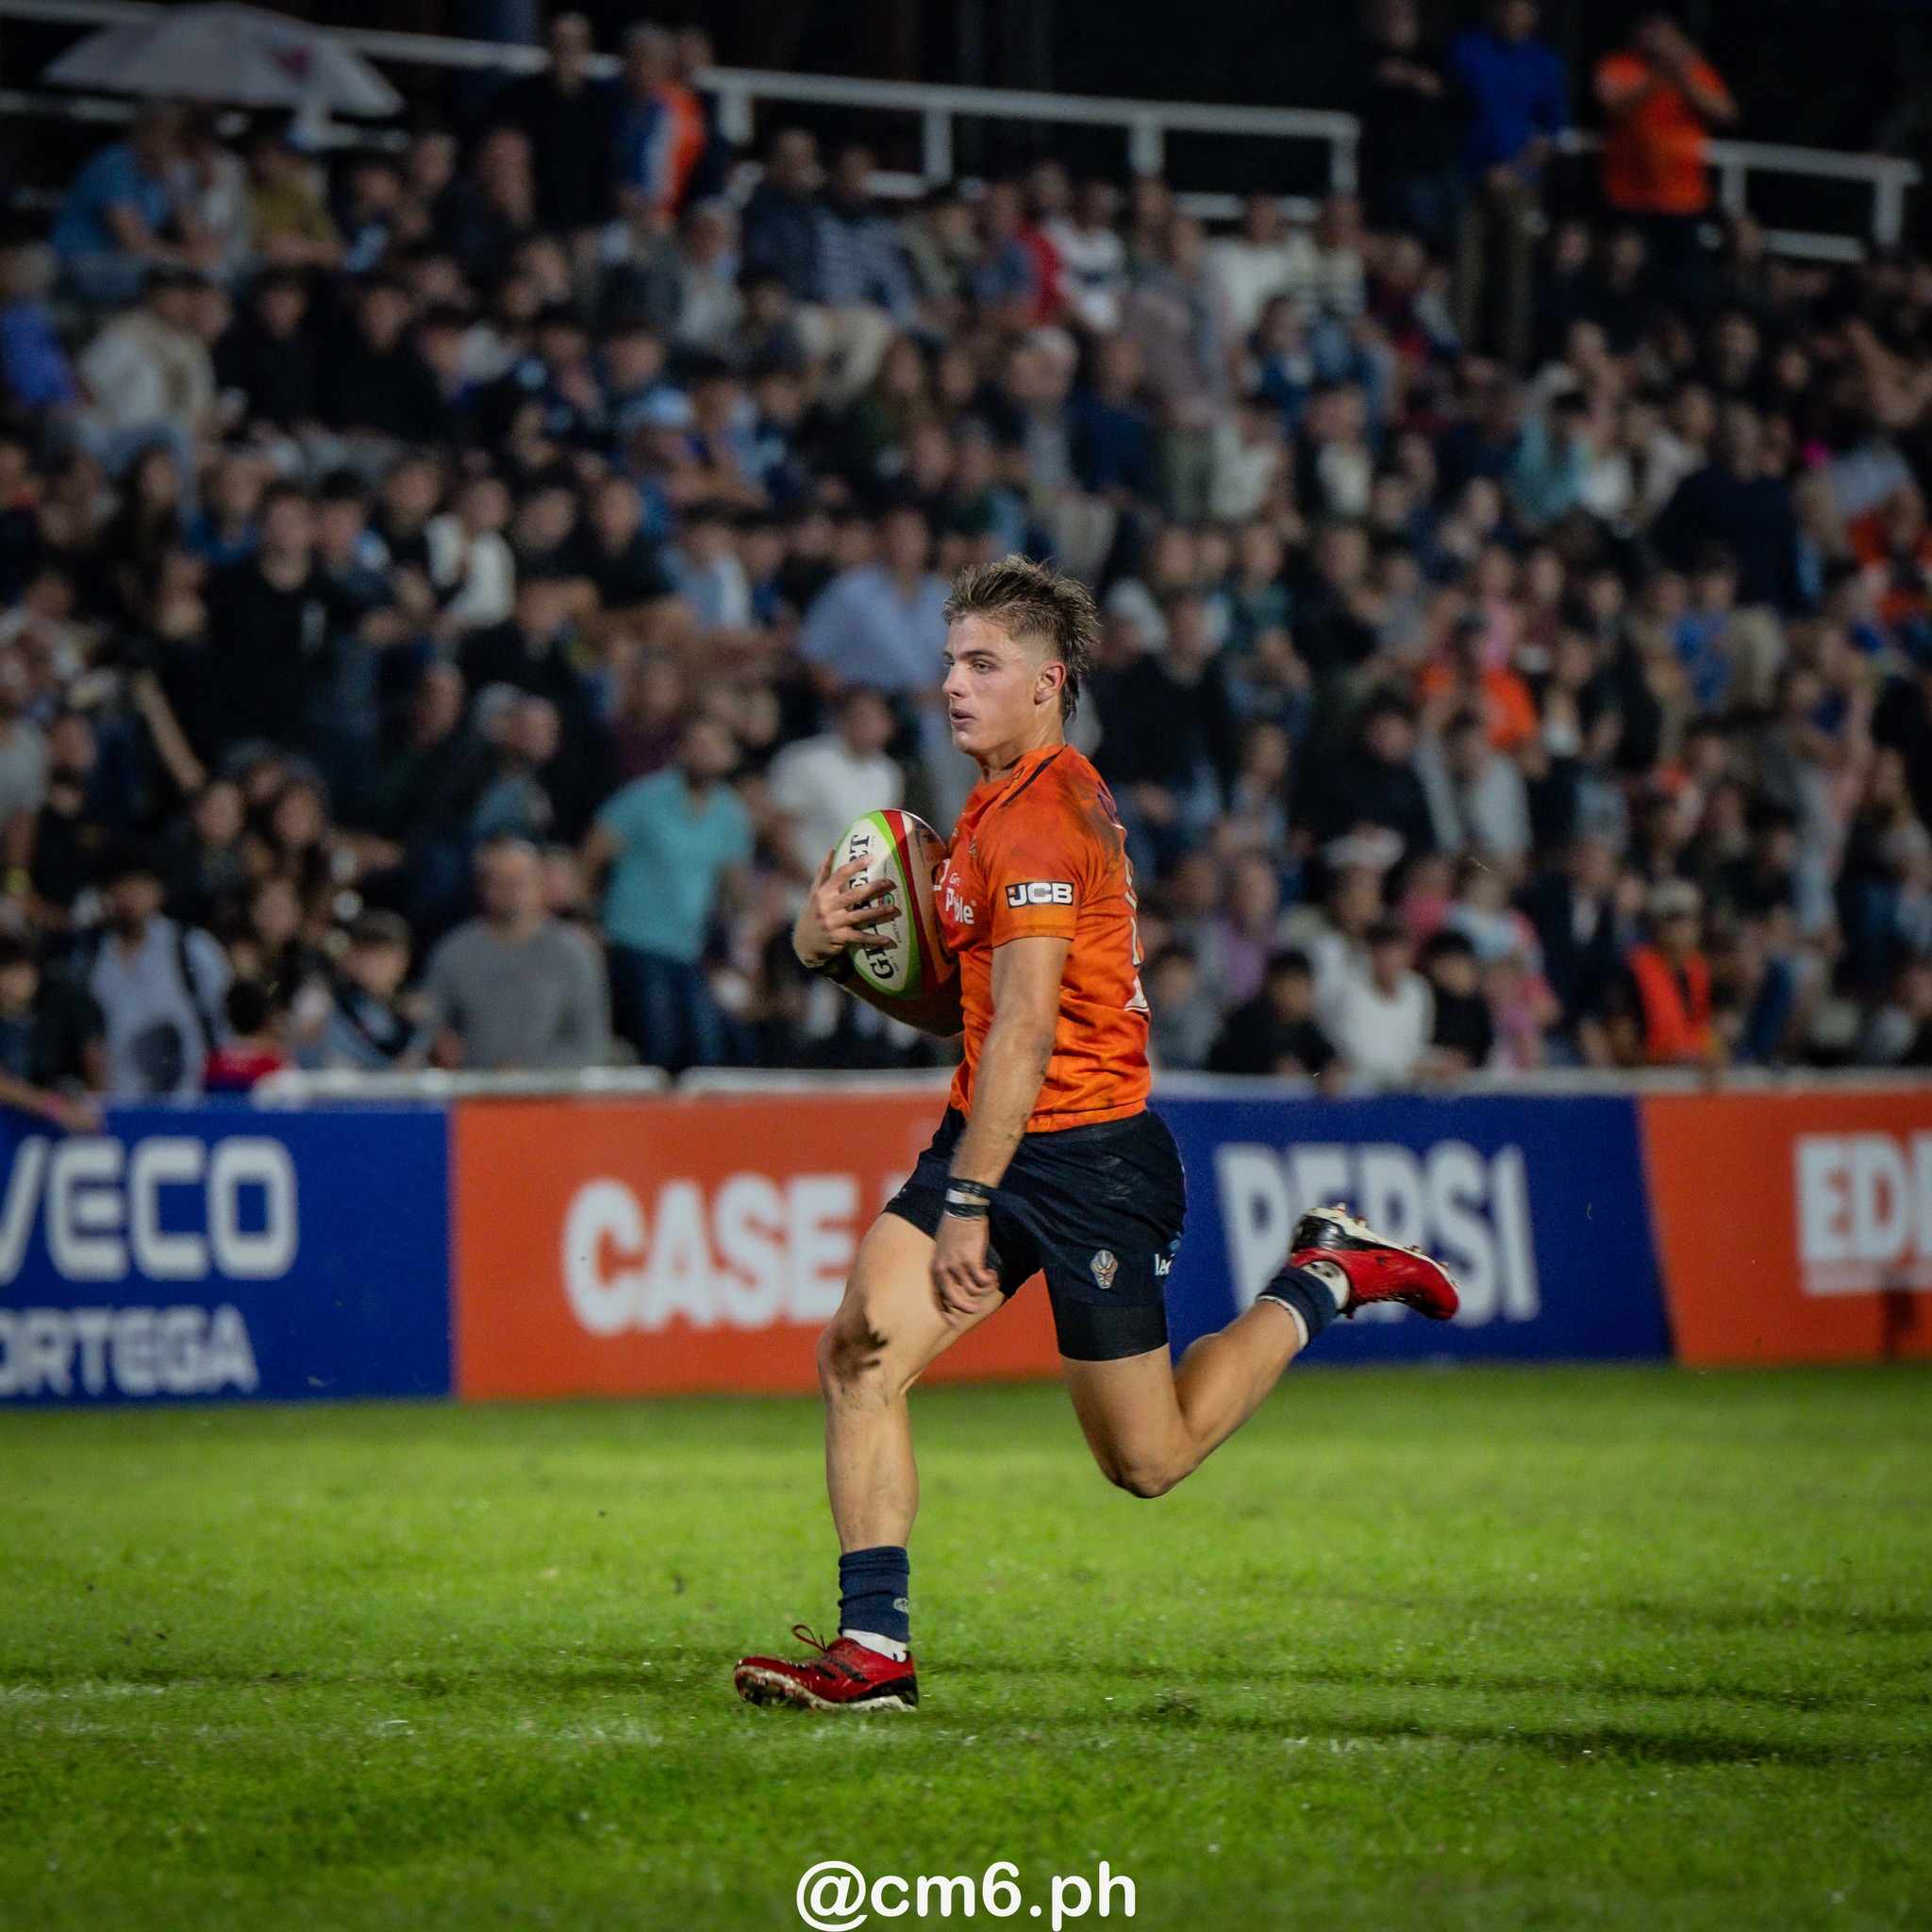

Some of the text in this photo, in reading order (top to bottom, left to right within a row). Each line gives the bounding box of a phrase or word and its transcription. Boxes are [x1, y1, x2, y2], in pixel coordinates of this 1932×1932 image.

[848, 834, 895, 979] GIET
[1008, 882, 1073, 907] JCB
[561, 1172, 860, 1336] CASE
